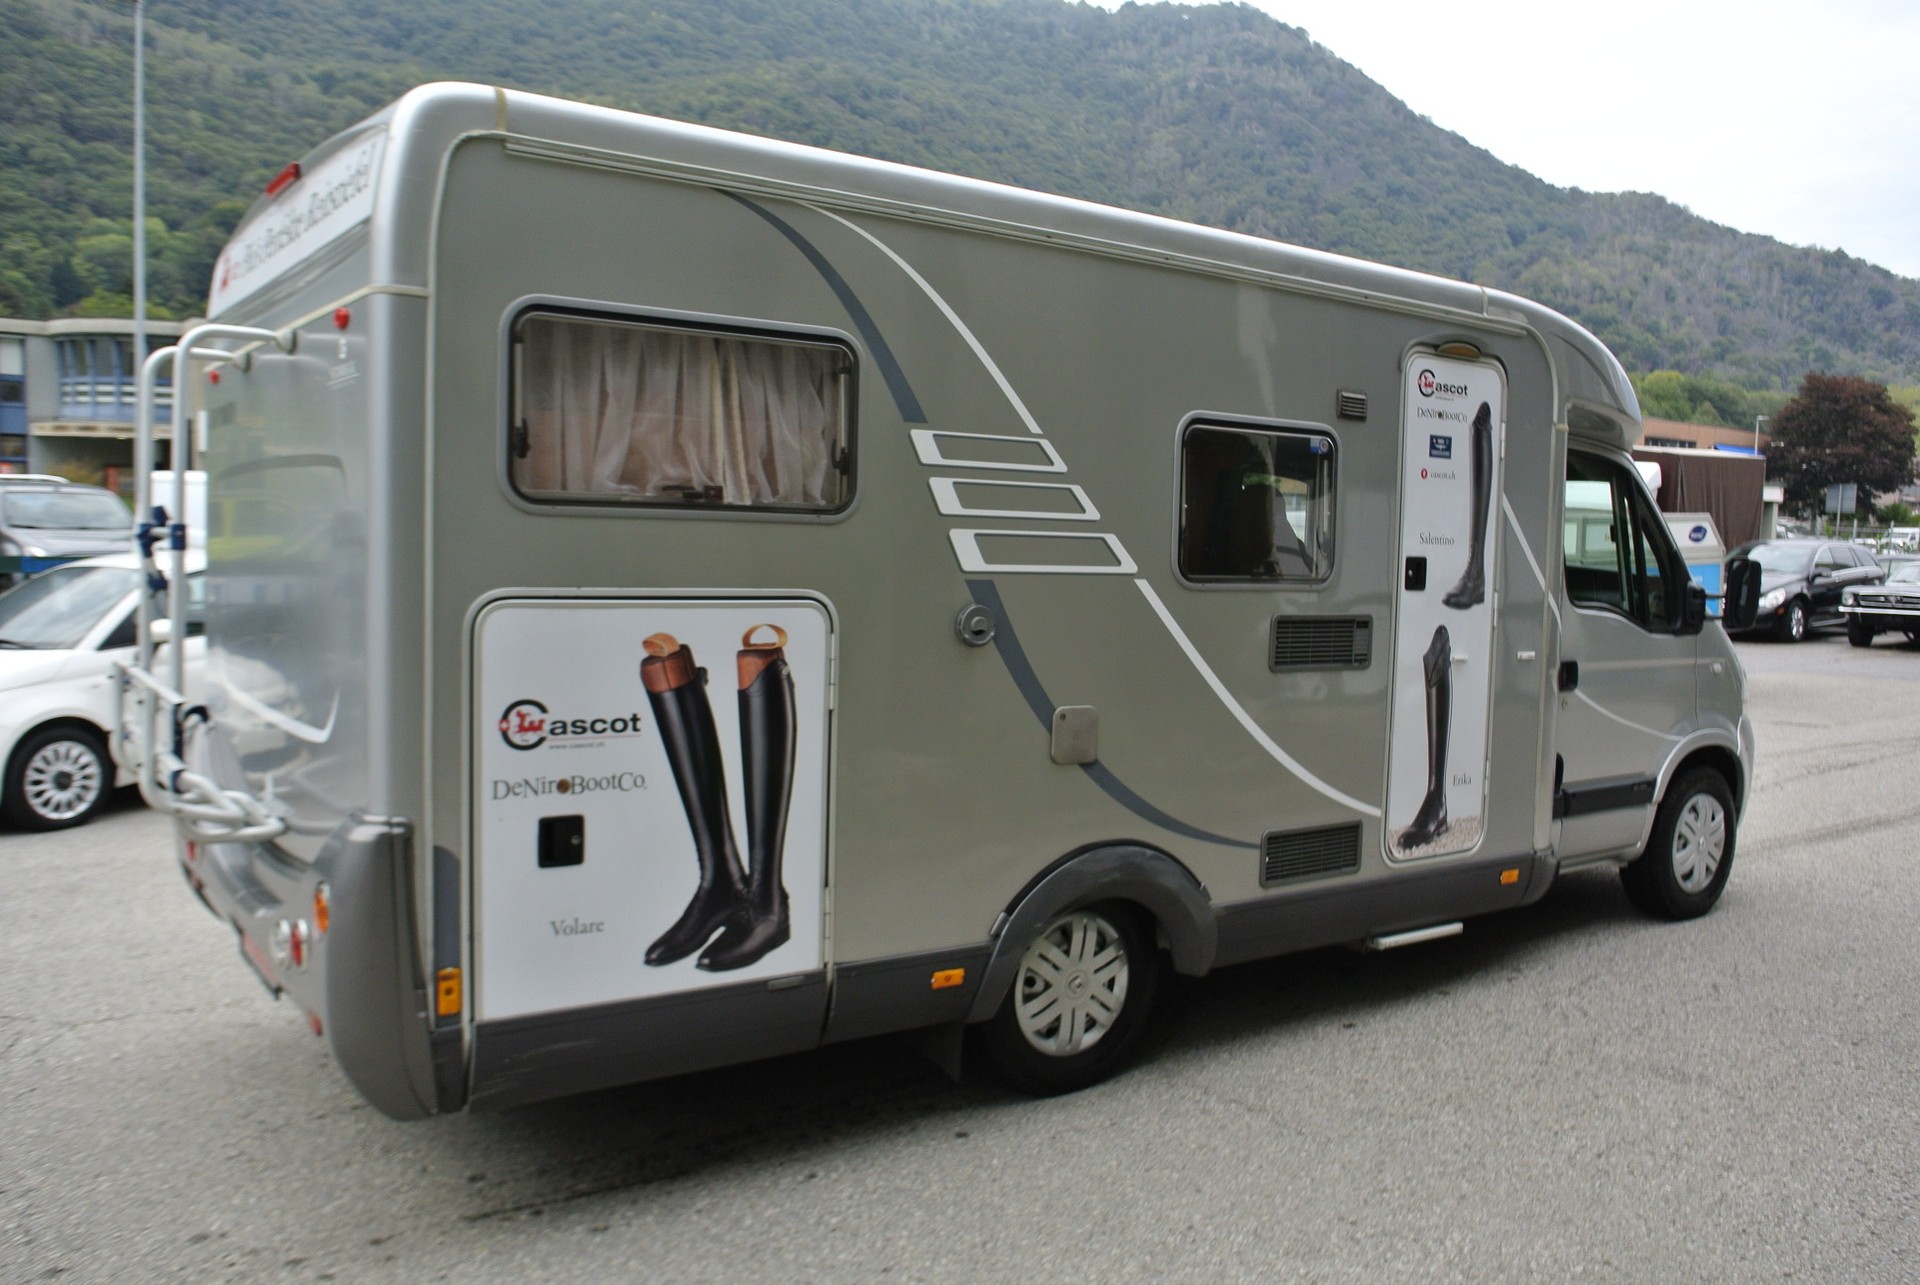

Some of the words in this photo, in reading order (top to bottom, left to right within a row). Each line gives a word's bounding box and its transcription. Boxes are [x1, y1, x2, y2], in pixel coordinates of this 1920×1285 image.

[1418, 369, 1468, 397] Cascot
[1419, 532, 1455, 546] Salentino
[500, 699, 641, 751] Cascot
[550, 918, 606, 937] Volare
